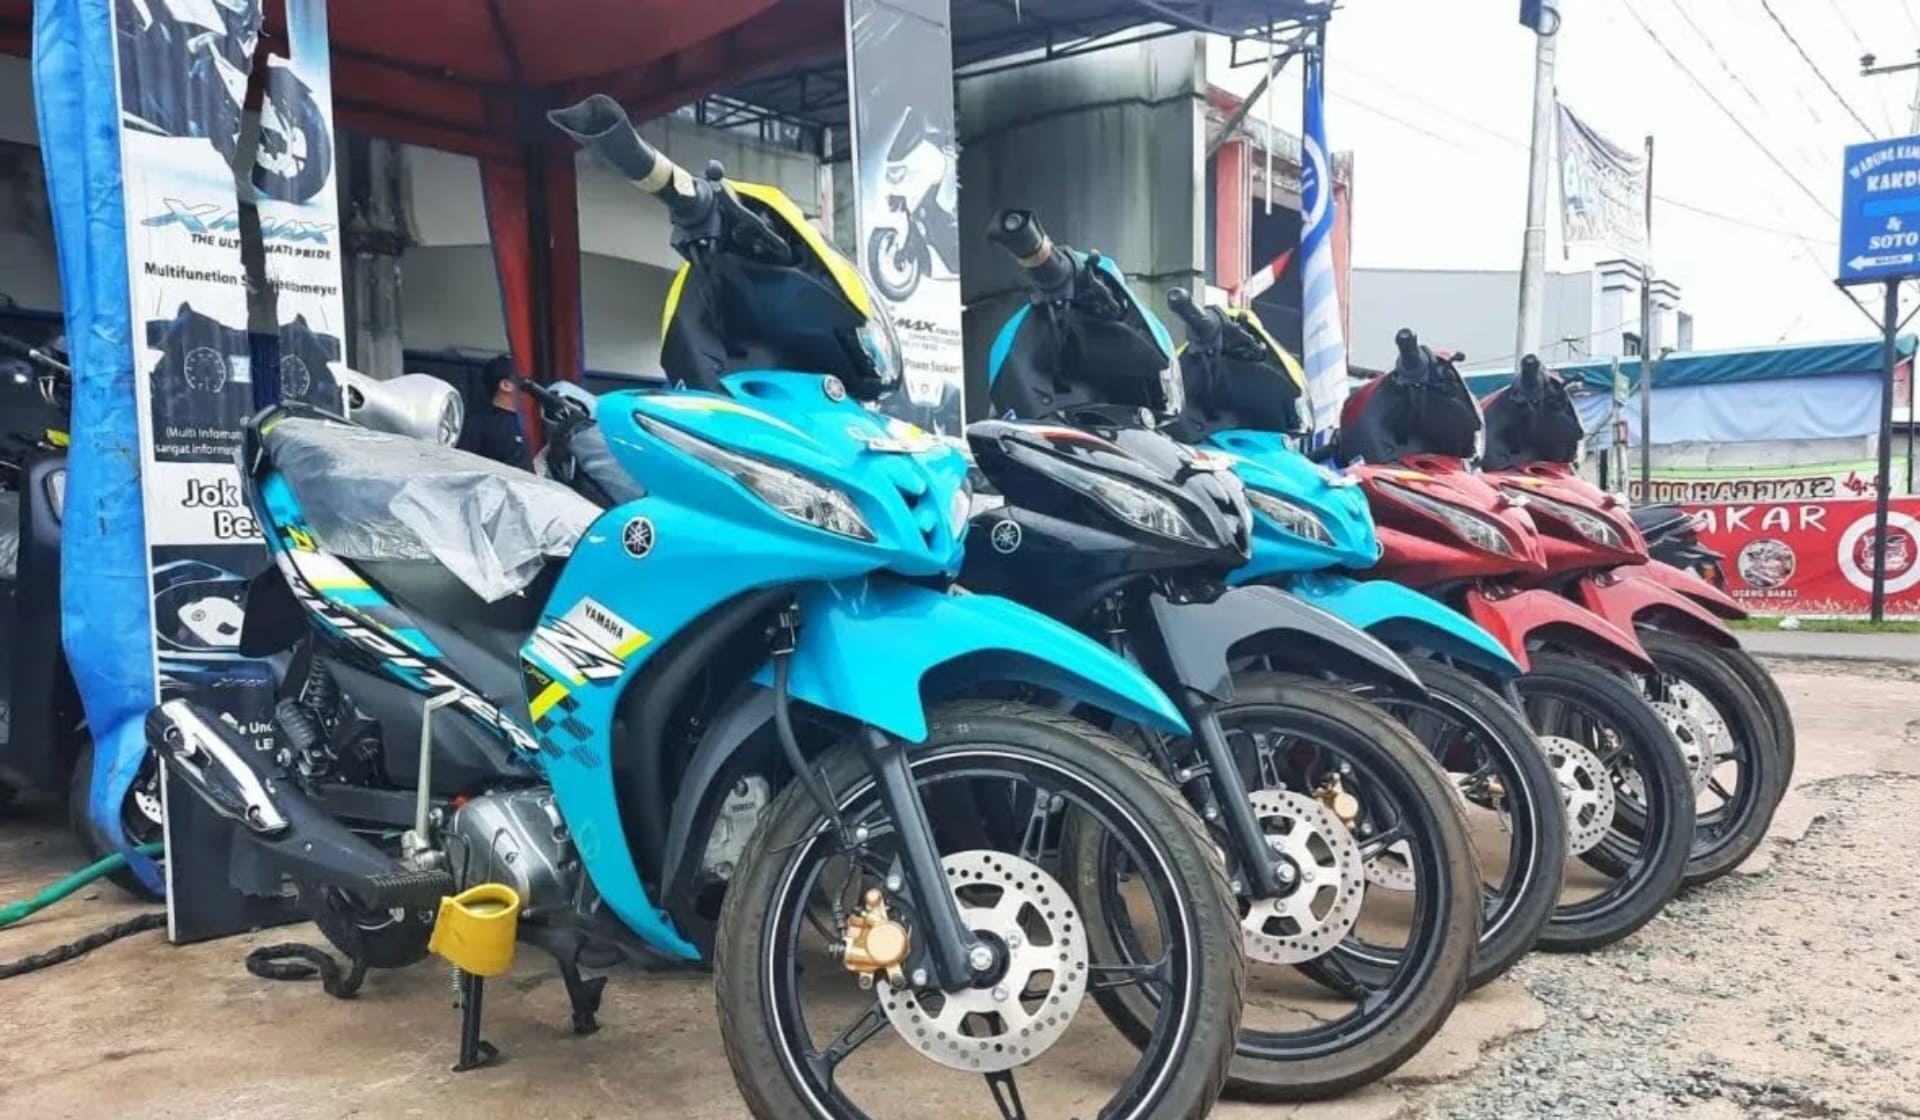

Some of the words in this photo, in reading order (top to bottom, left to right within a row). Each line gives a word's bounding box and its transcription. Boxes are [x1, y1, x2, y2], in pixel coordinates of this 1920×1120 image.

[191, 233, 216, 246] THE
[1868, 231, 1918, 250] SOTO
[181, 477, 239, 508] Jok
[584, 604, 624, 641] YAMAHA
